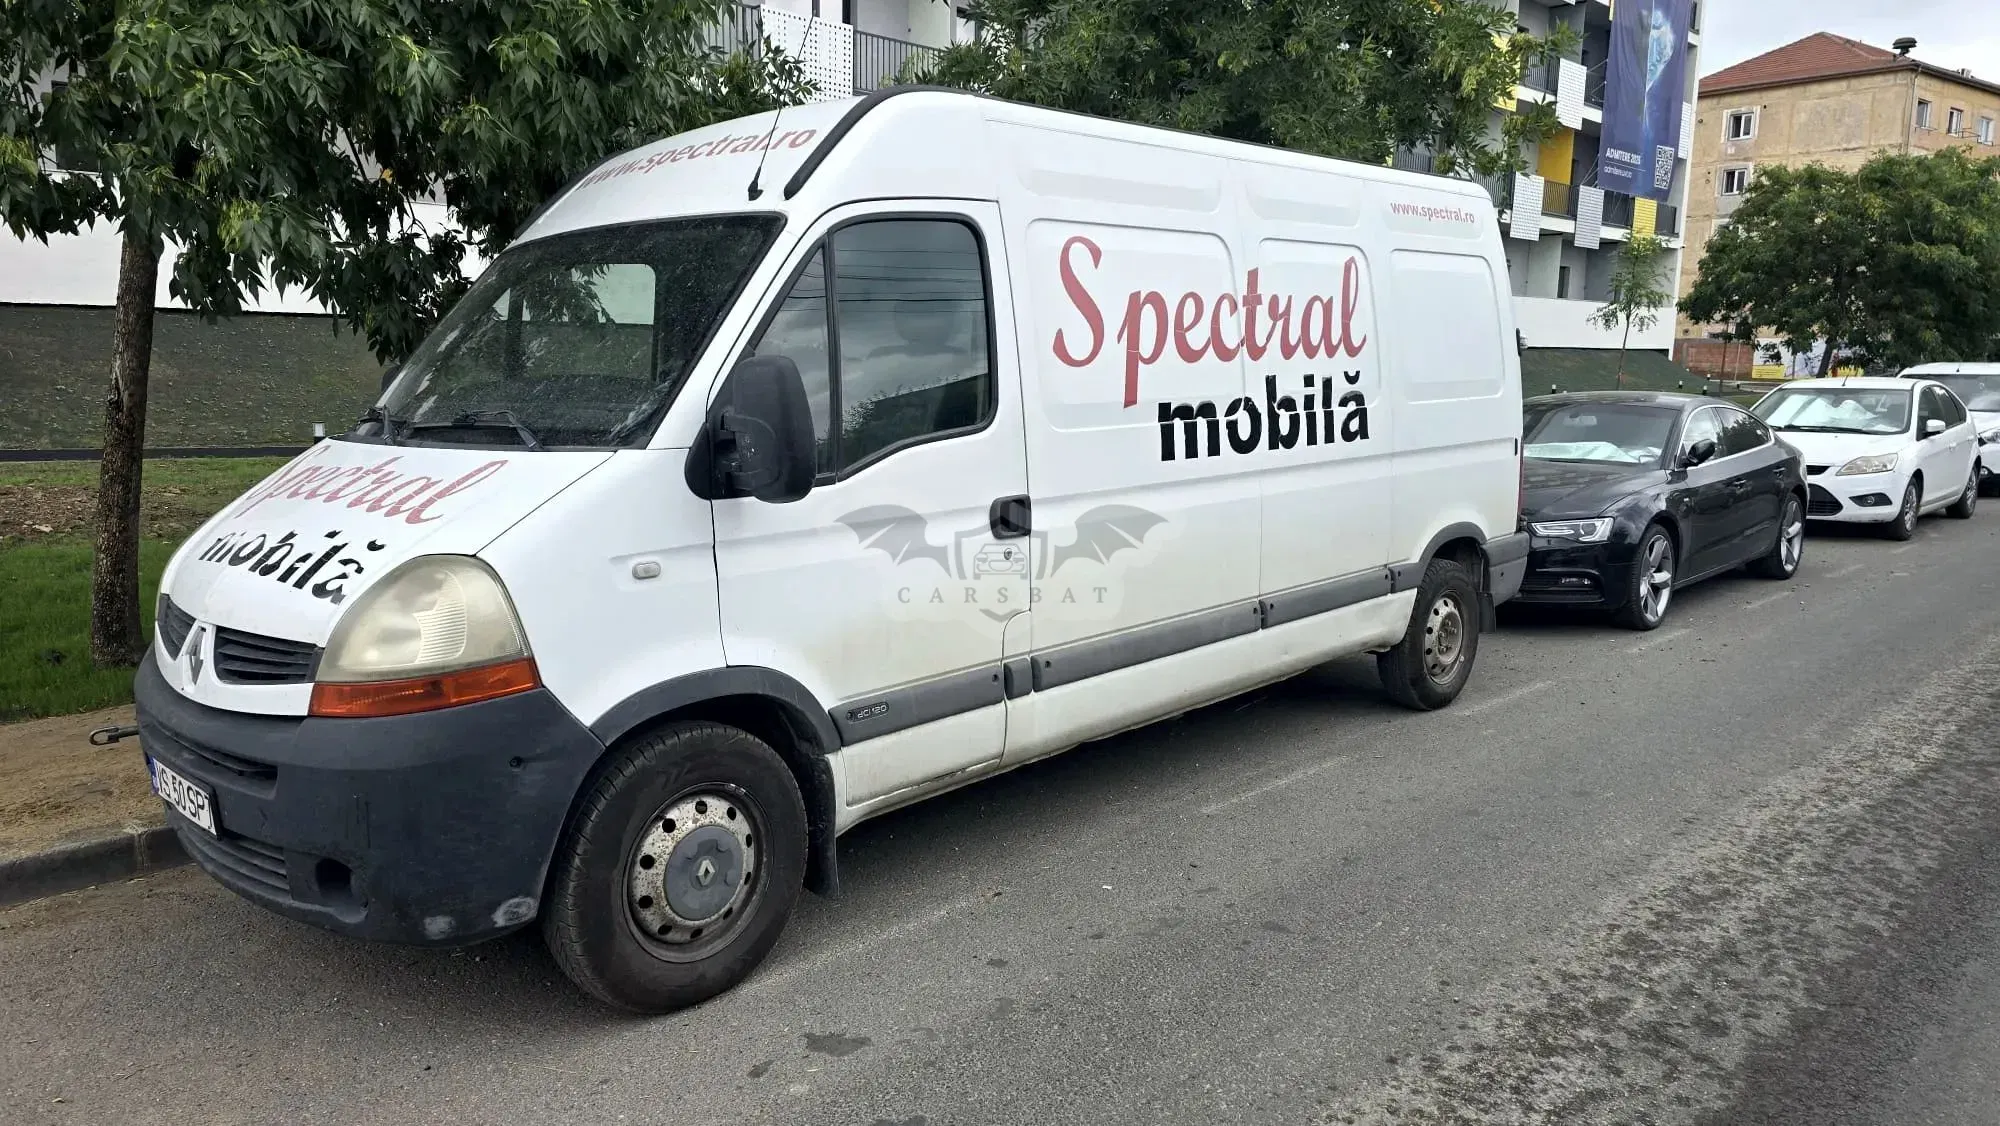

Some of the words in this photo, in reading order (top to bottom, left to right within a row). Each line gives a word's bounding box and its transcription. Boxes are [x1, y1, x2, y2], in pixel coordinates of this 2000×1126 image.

[574, 126, 817, 191] www.spectral.ro
[1390, 202, 1475, 223] www.spectral.ro
[1053, 235, 1367, 409] Spectral
[1158, 370, 1370, 462] mobilă
[234, 444, 509, 525] Spectral
[198, 530, 388, 606] mobilă
